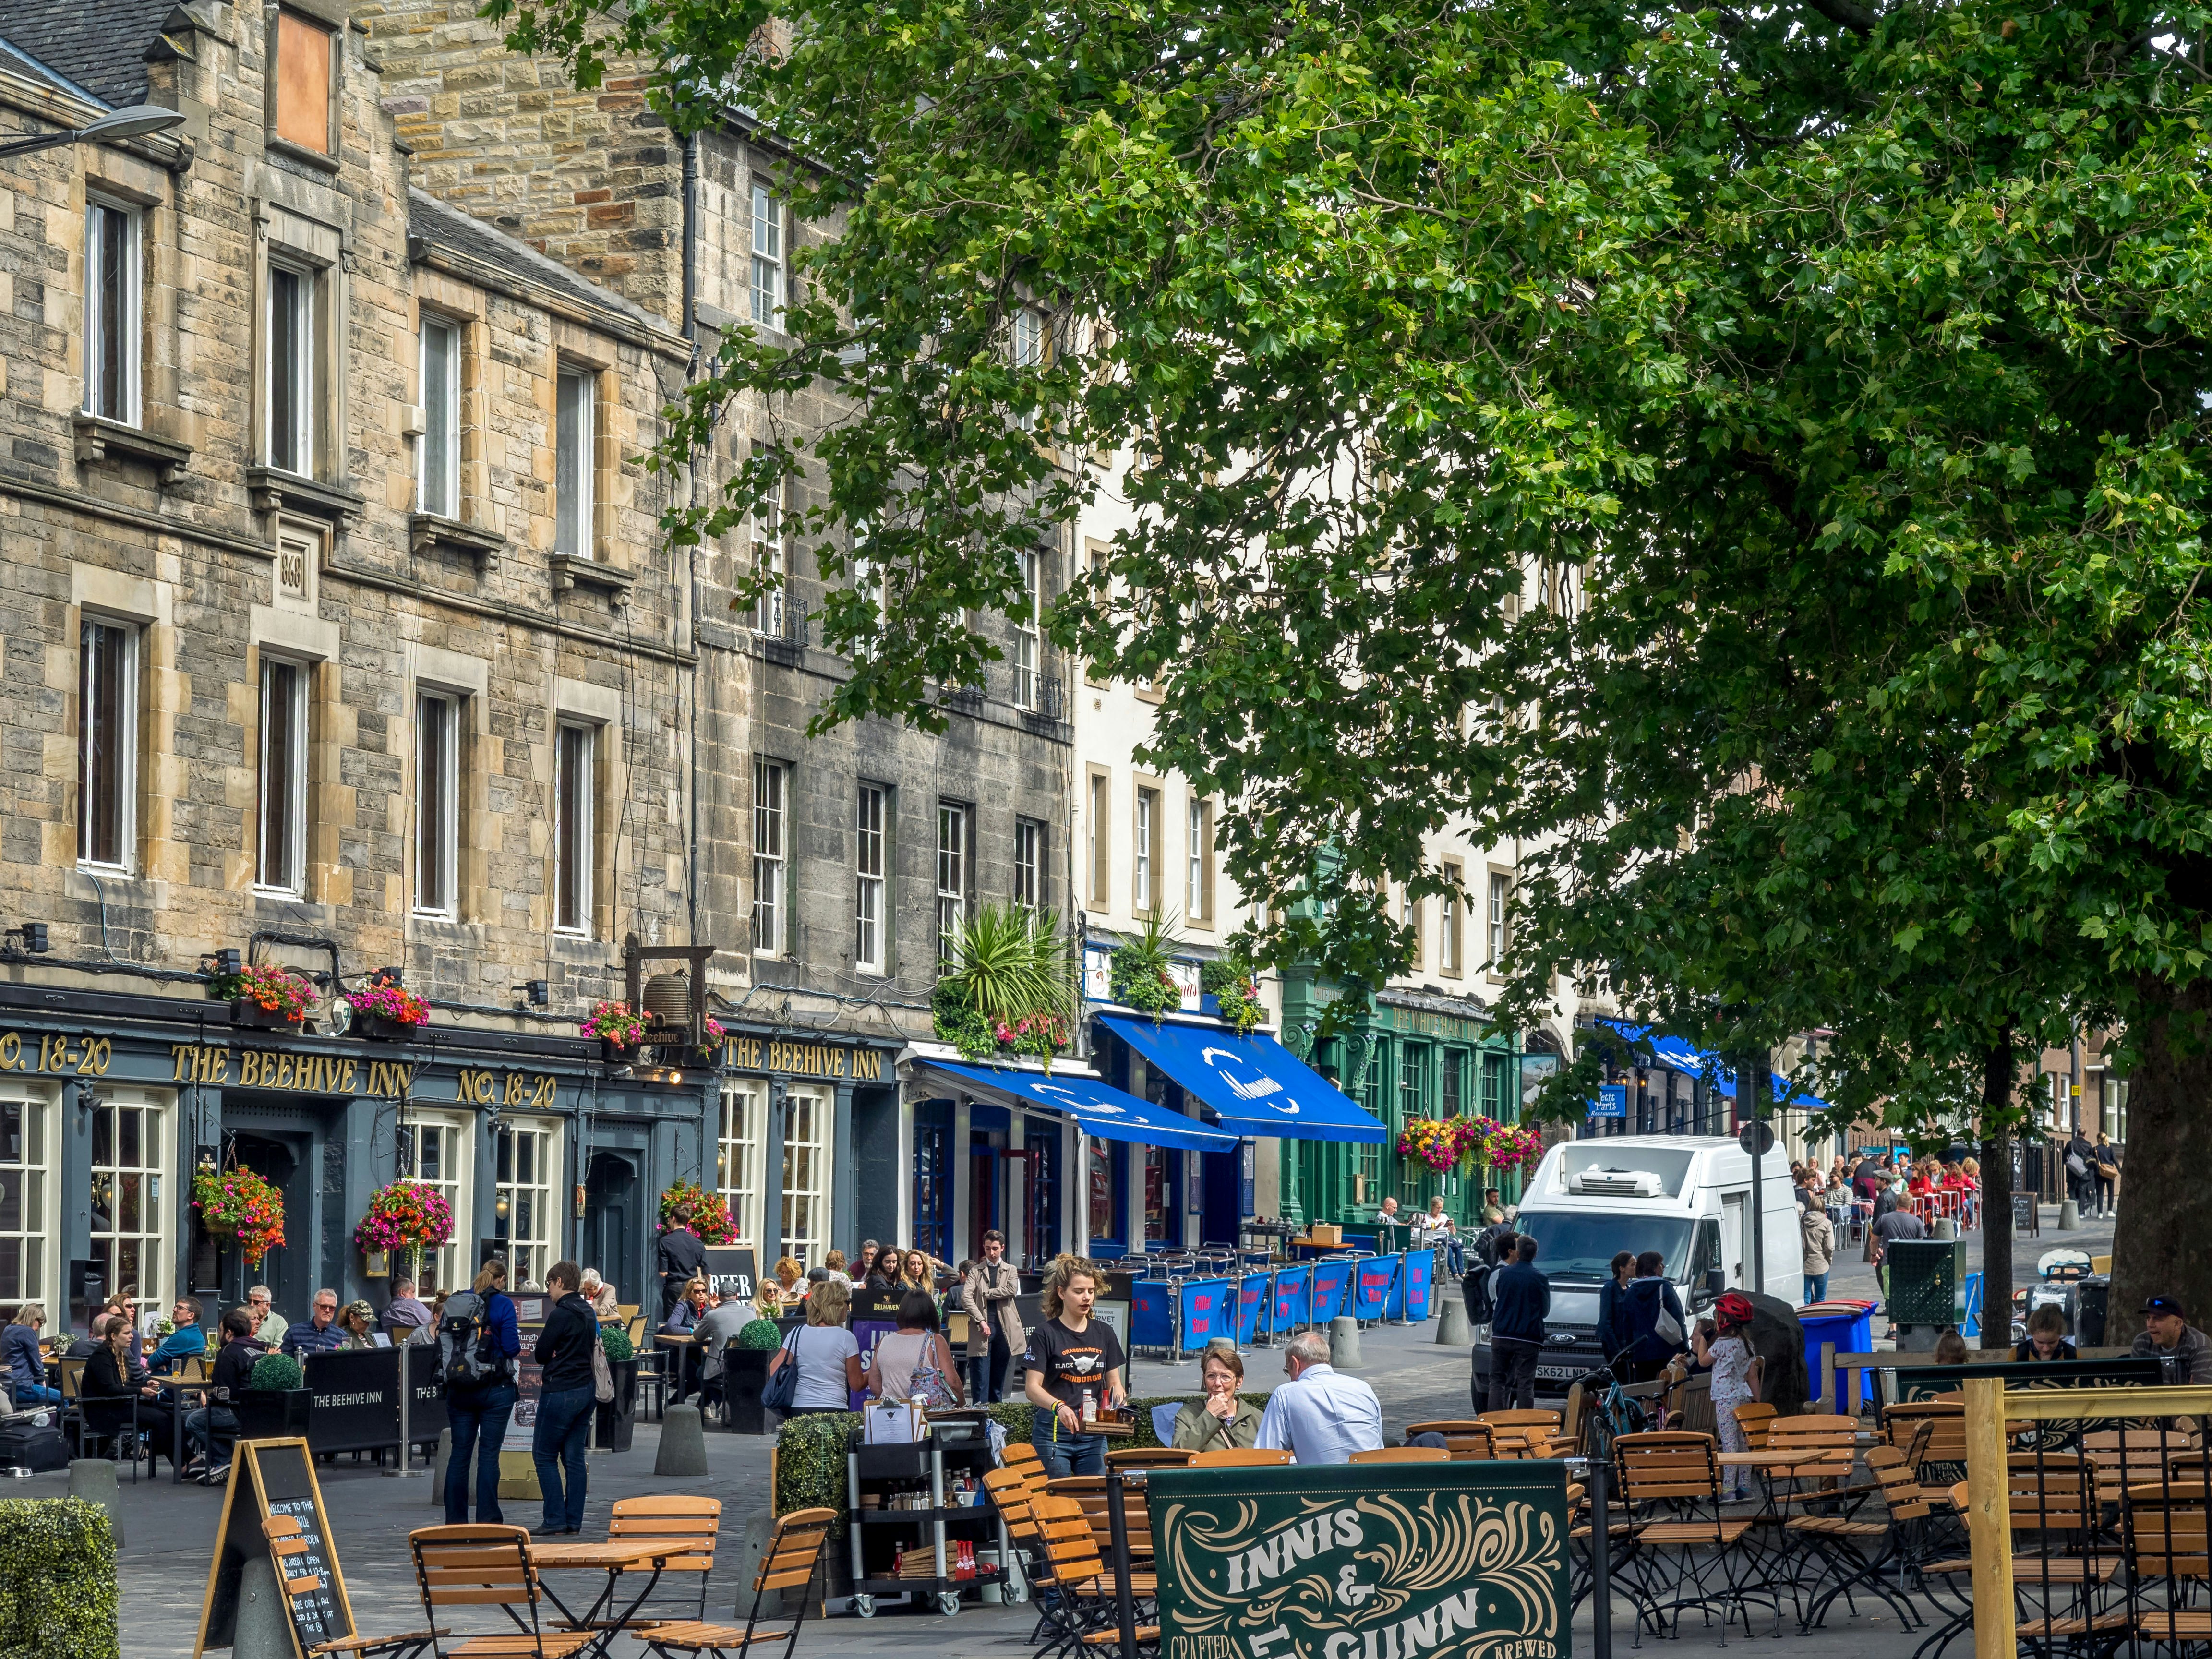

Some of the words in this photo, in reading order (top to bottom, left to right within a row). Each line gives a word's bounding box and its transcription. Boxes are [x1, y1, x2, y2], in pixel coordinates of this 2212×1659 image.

[1393, 1008, 1410, 1029] THE
[1411, 1010, 1440, 1035] WHITE
[1440, 1015, 1465, 1039] HART
[1467, 1021, 1483, 1041] INN
[37, 1034, 111, 1075] 18-20
[725, 1036, 762, 1069] THE
[769, 1041, 845, 1077] BEEHIVE
[852, 1049, 881, 1080] INN
[172, 1045, 229, 1084] THE
[239, 1050, 357, 1094] BEEHIVE
[366, 1061, 412, 1097] INN
[457, 1070, 495, 1104] NO.
[503, 1072, 556, 1108] 18-20
[1594, 1101, 1616, 1111] Paris
[199, 1161, 216, 1170] BEAVEN
[874, 1303, 901, 1311] BELHAVEN
[1061, 1347, 1103, 1356] GRASSMARKET
[1060, 1373, 1102, 1383] EDINBURGH
[1537, 1367, 1563, 1378] SK62
[314, 1395, 330, 1407] THE
[332, 1393, 365, 1406] BEEHIVE
[366, 1391, 382, 1403] INN
[292, 1503, 301, 1511] TO
[301, 1501, 313, 1511] THE
[1227, 1508, 1363, 1594] INNIS
[289, 1557, 301, 1567] AREA
[307, 1556, 320, 1565] OPEN
[285, 1569, 297, 1578] DAILY
[1335, 1564, 1375, 1606] &
[293, 1600, 303, 1610] EASE
[321, 1597, 330, 1606] ALL
[306, 1612, 311, 1621] &
[327, 1610, 334, 1619] AT
[305, 1623, 315, 1633] THE
[1323, 1588, 1479, 1659] GUNN
[1494, 1639, 1556, 1659] BREWED
